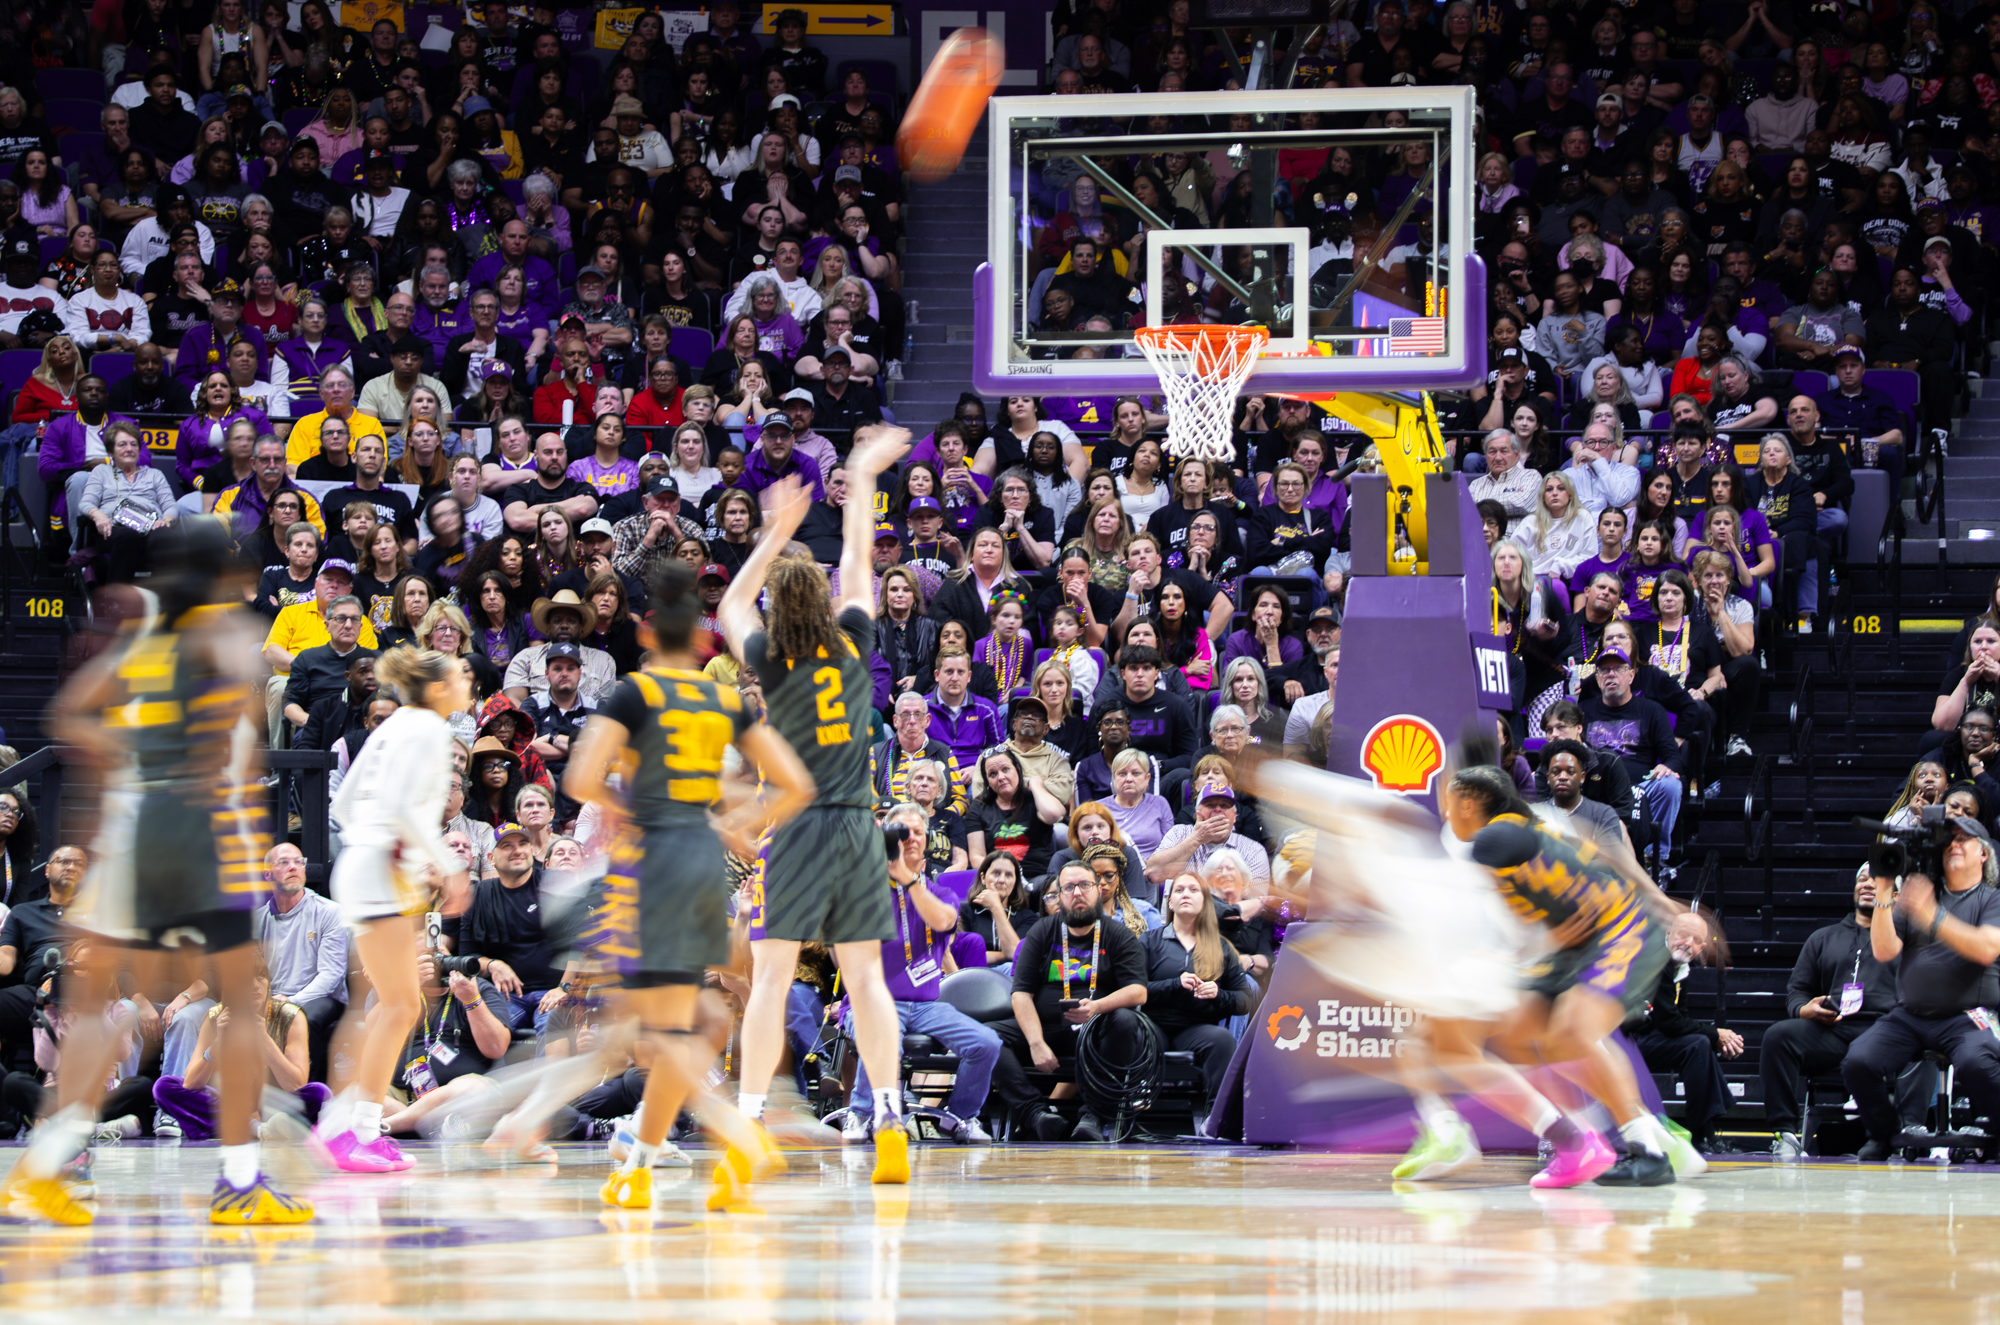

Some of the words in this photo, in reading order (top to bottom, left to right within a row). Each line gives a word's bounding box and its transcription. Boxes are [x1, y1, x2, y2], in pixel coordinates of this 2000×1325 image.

[1008, 364, 1053, 376] SPALDING
[1321, 416, 1340, 431] LSU
[140, 431, 170, 447] 08
[587, 474, 625, 487] LSU
[920, 497, 929, 507] L
[875, 522, 894, 531] LSU
[25, 598, 64, 618] 108
[1475, 646, 1510, 694] YETI
[813, 666, 847, 721] 2
[815, 722, 852, 746] KNOX
[1130, 719, 1165, 736] SU
